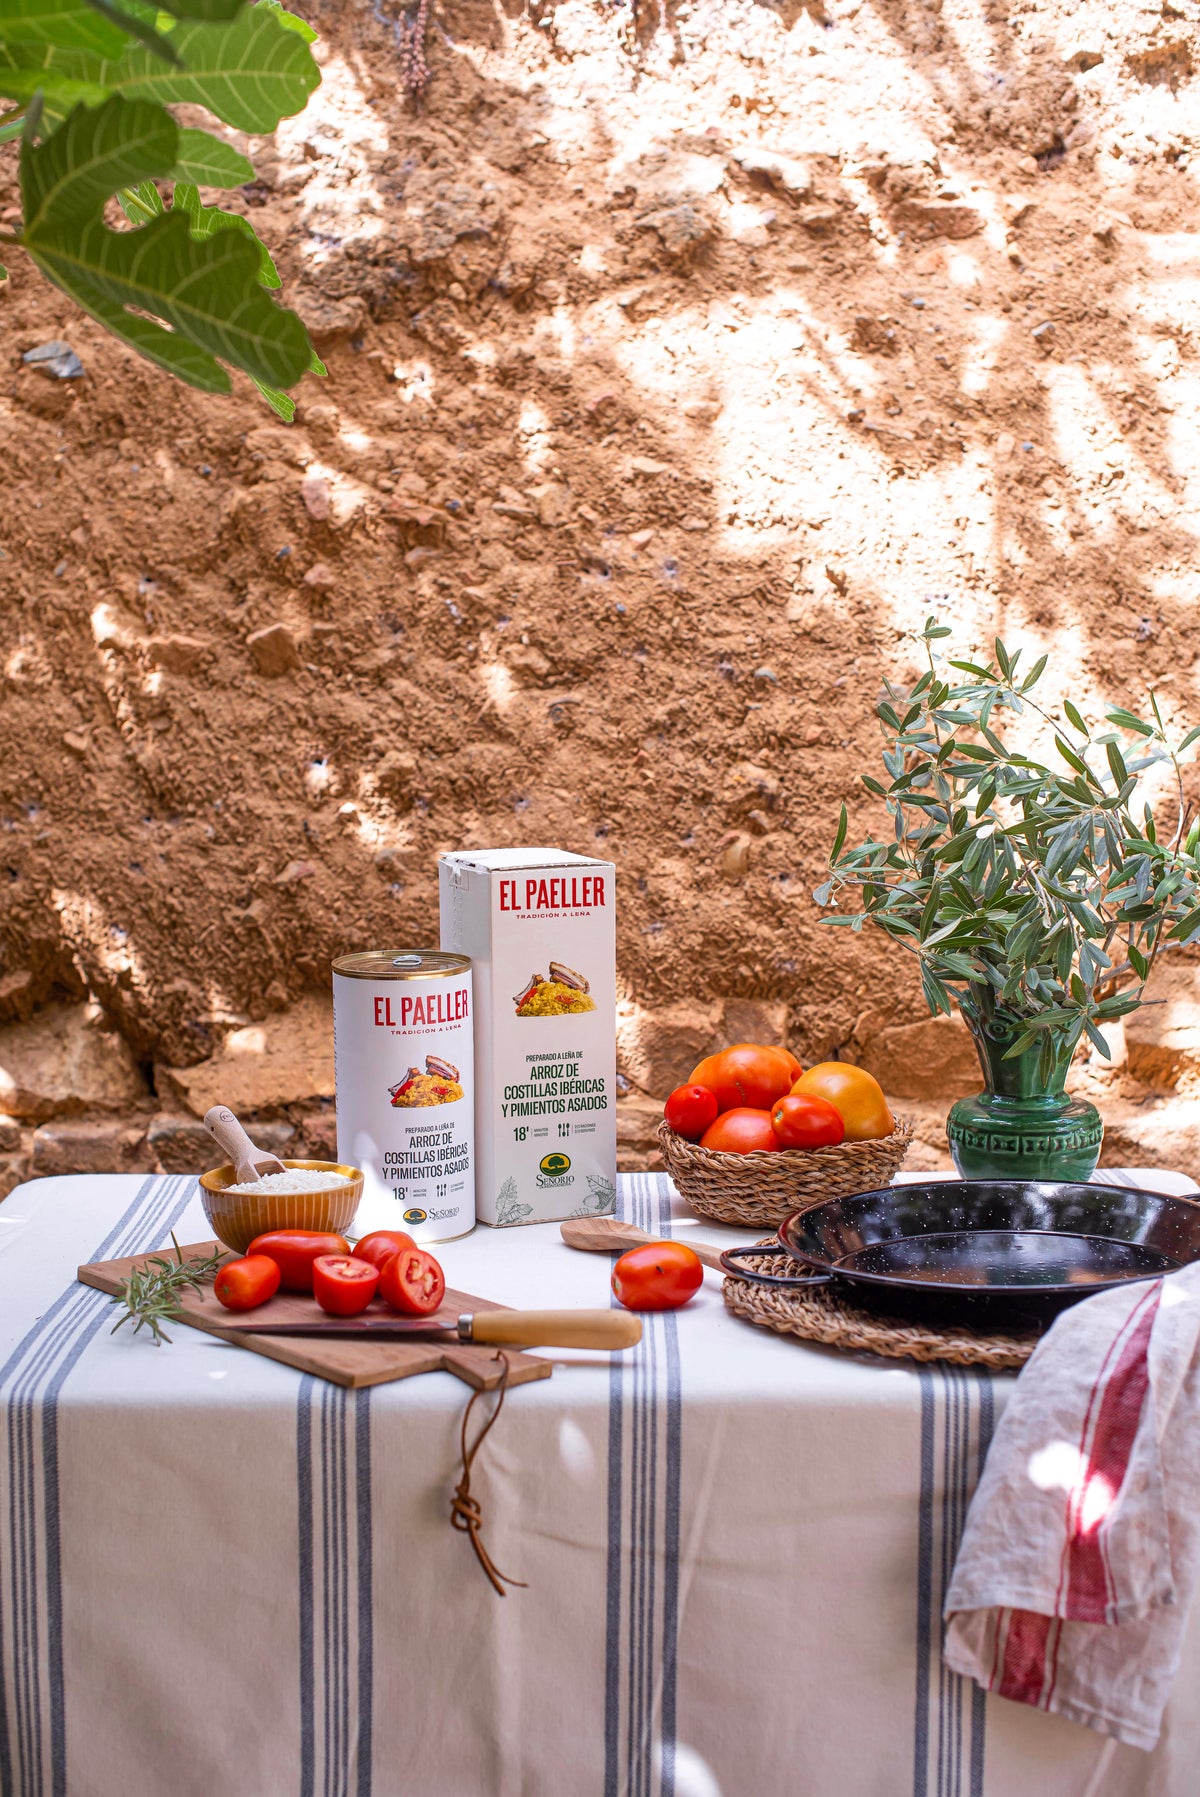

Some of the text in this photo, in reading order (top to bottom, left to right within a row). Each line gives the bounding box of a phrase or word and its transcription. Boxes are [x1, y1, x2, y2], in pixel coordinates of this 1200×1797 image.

[500, 876, 606, 911] EL PAELLER
[516, 912, 560, 920] TRADICIÓN
[374, 989, 469, 1027] EL PAELLER
[390, 1028, 436, 1036] TRADICIÓN
[525, 1051, 583, 1063] PREPARADO A LEÑA DE
[530, 1063, 579, 1081] ARROZ DE
[504, 1078, 605, 1100] COSTILLAS IBÉRICAS
[501, 1095, 608, 1118] Y PIMIENTOS ASADOS
[405, 1125, 434, 1134] PREPARADO
[439, 1122, 449, 1131] LEÑA
[450, 1121, 455, 1129] DE
[409, 1131, 453, 1149] ARROZ DE
[384, 1142, 468, 1165] COSTILLAS IBÉRICAS
[382, 1157, 470, 1180] Y PIMIENTOS ASADOS
